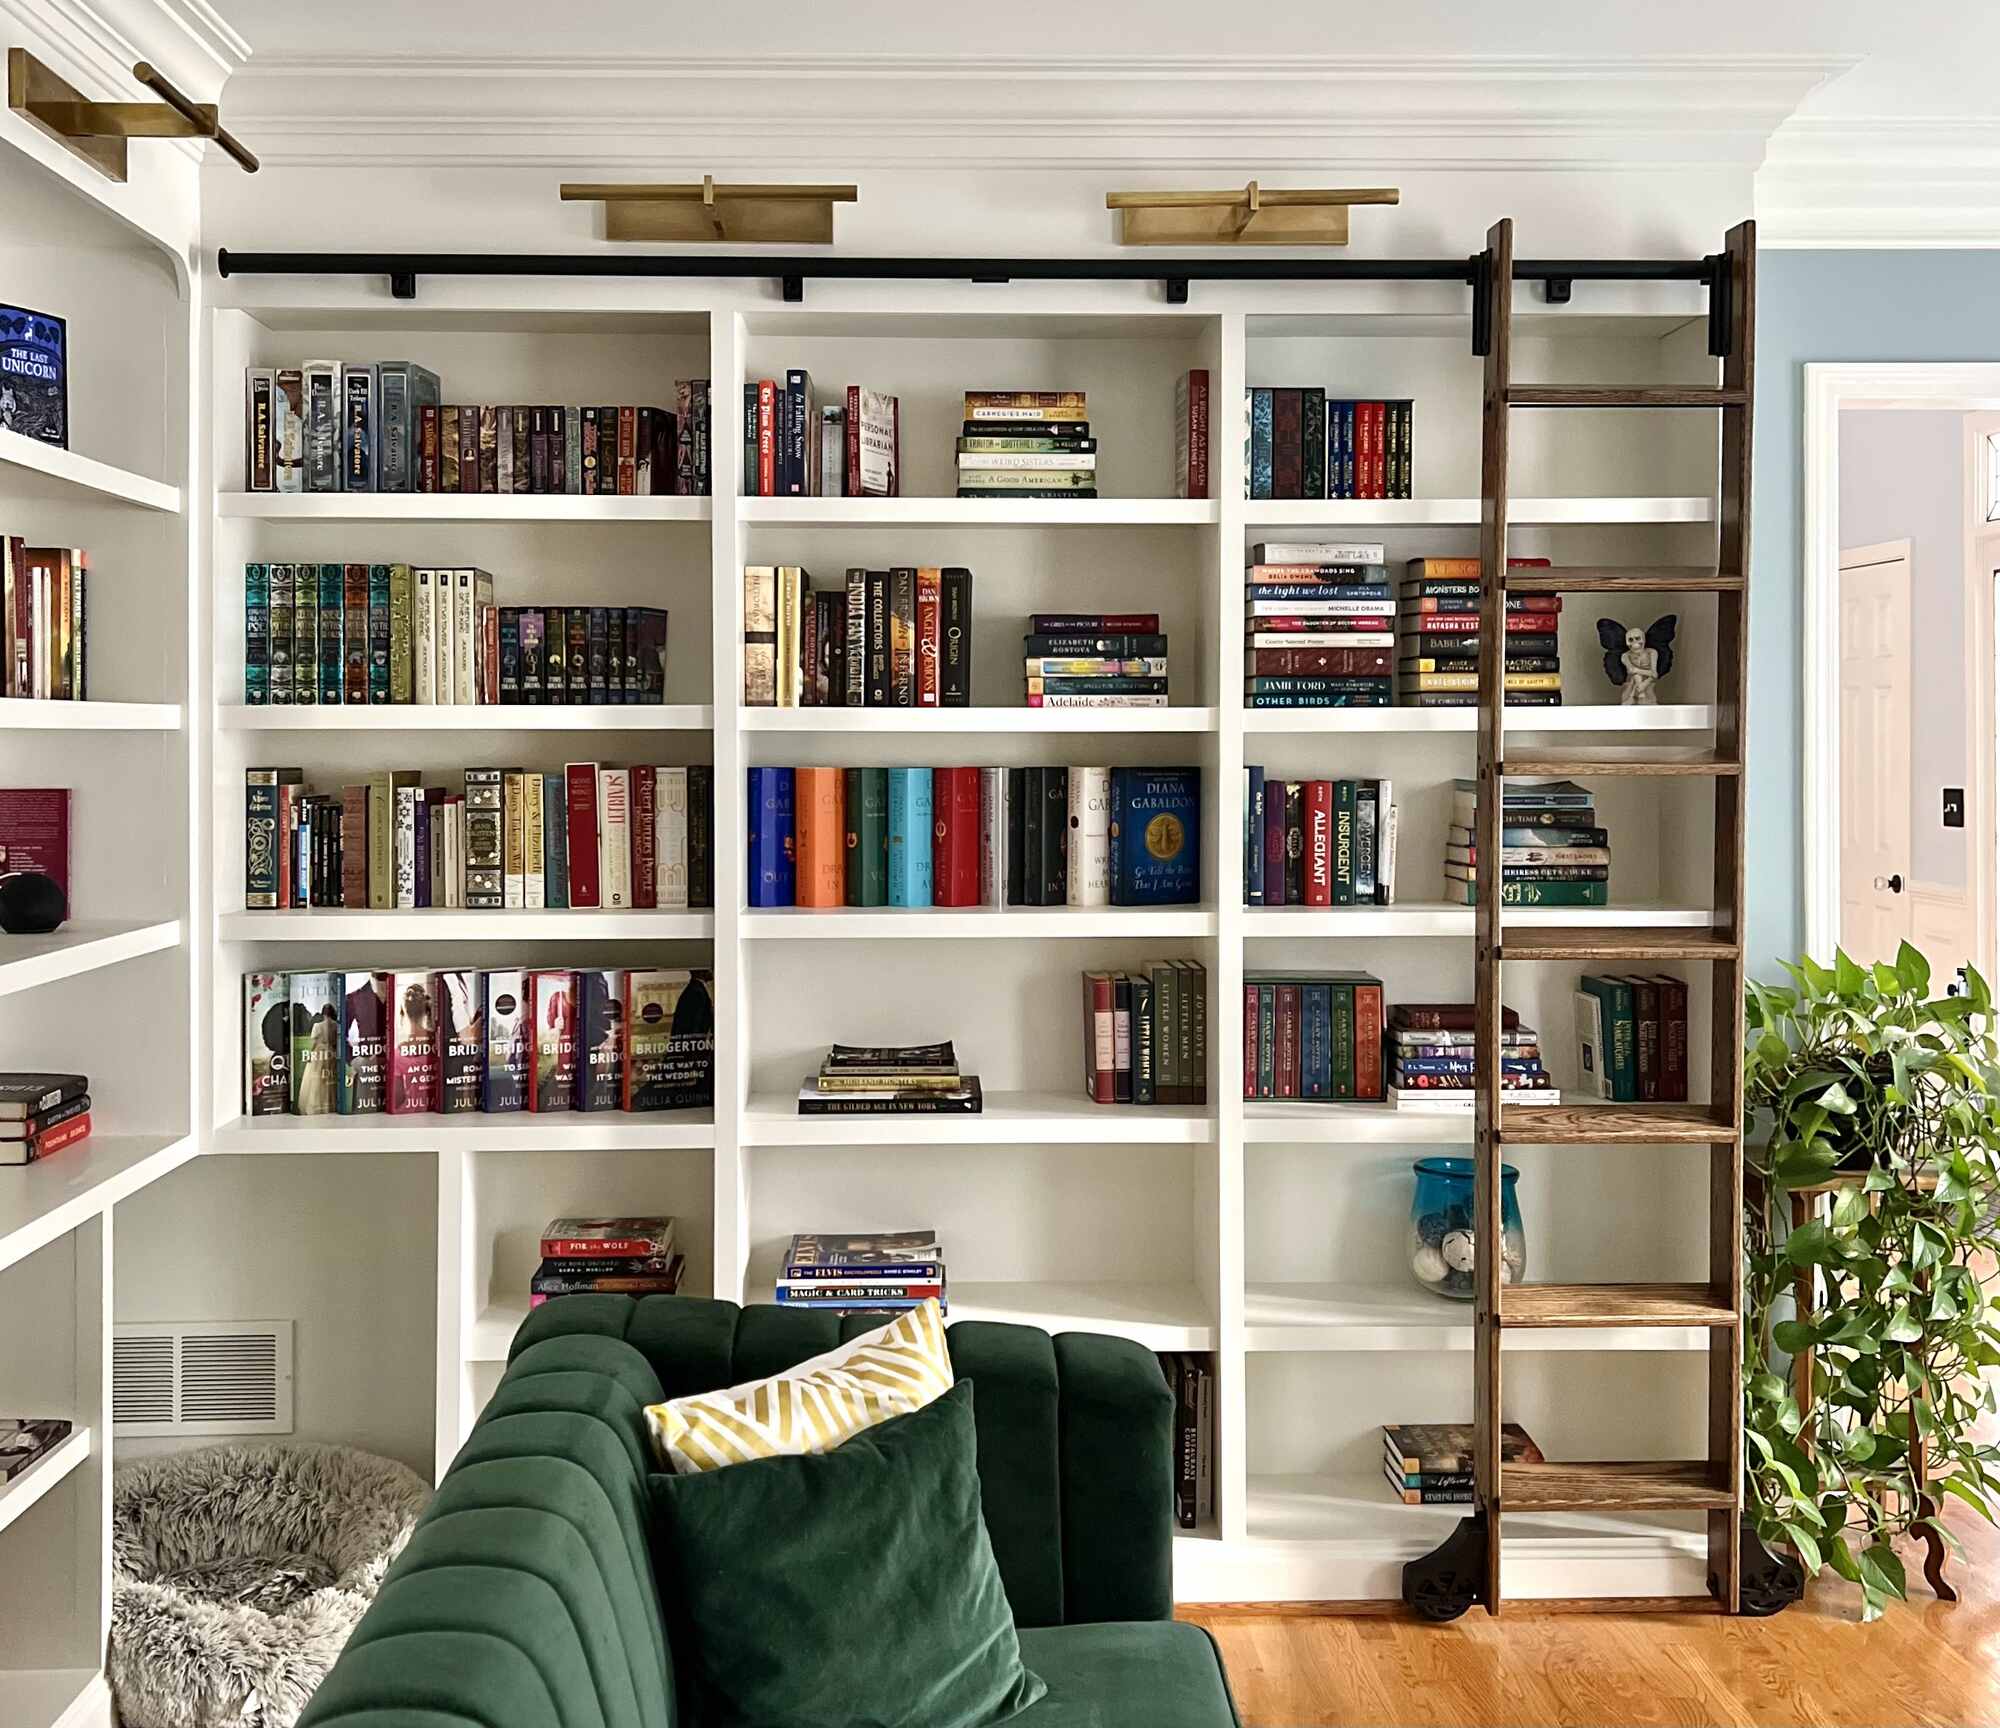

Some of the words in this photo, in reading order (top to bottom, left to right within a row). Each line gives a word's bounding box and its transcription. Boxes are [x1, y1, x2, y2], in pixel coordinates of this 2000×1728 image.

[11, 347, 28, 360] THE
[30, 351, 49, 364] LAST
[2, 356, 57, 380] UNICORN
[761, 387, 771, 404] The
[795, 393, 804, 402] In
[1198, 386, 1207, 398] AS
[257, 403, 267, 423] R.A.
[353, 404, 362, 423] R.A.
[761, 405, 771, 426] Plum
[793, 405, 803, 433] Falling
[1198, 401, 1207, 432] BRIGHT
[860, 420, 893, 438] PERSONAL
[257, 424, 267, 469] Salvatore
[316, 425, 327, 471] Salvatore
[353, 426, 362, 475] Salvatore
[390, 427, 398, 473] Salvatore
[761, 429, 771, 454] Trees
[795, 436, 804, 459] Snow
[861, 437, 894, 452] LIBRARIAN
[1198, 435, 1207, 448] AS
[1020, 456, 1054, 465] SISTERS
[1198, 450, 1207, 486] HEAVEN
[873, 580, 882, 597] THE
[897, 570, 908, 595] DAN
[922, 588, 936, 596] DAN
[1258, 586, 1272, 595] the
[1274, 586, 1300, 598] light
[1318, 586, 1339, 595] lost
[1425, 585, 1467, 594] MONSTERS
[849, 582, 865, 617] INDIA
[918, 595, 940, 603] BROWN
[848, 618, 865, 641] FAN
[873, 598, 882, 650] COLLECTORS
[923, 605, 934, 641] ANGELS
[921, 638, 937, 657] &
[947, 627, 962, 665] ORIGIN
[1429, 639, 1463, 648] BABEL
[895, 650, 910, 705] INFERNO
[923, 656, 934, 691] DEMONS
[1263, 681, 1292, 690] JAMIE
[1296, 681, 1326, 690] FORD
[1046, 695, 1095, 707] Adelaide
[1256, 697, 1293, 705] OTHER
[1298, 697, 1330, 705] BIRDS
[530, 778, 541, 807] Darcy
[641, 780, 655, 811] RHETT
[1146, 783, 1185, 794] DIANA
[511, 787, 521, 813] Darcy
[605, 775, 625, 825] SCARLETT
[1131, 797, 1195, 809] GABALDON
[511, 818, 521, 844] Takes
[641, 813, 655, 854] BUTLER'S
[531, 824, 541, 873] Elizabeth
[1313, 809, 1326, 886] ALLEGIANT
[1337, 810, 1350, 885] INSURGENT
[1360, 820, 1371, 885] DIVERGENT
[511, 852, 521, 872] Wife
[641, 857, 655, 891] PEOPLE
[1135, 879, 1151, 890] That
[1181, 993, 1189, 1029] LITTLE
[1141, 1015, 1150, 1046] LITTLE
[635, 1039, 715, 1055] BRIDGERTON
[1181, 1036, 1189, 1059] MEN
[361, 1065, 380, 1074] THE
[407, 1066, 420, 1074] AN
[503, 1064, 516, 1072] TO
[642, 1063, 656, 1072] ON
[657, 1062, 676, 1071] THE
[676, 1061, 695, 1069] WAY
[695, 1060, 709, 1068] TO
[1141, 1047, 1150, 1079] WOMEN
[1449, 1060, 1468, 1072] Mrs.
[360, 1075, 382, 1084] WHO
[446, 1076, 477, 1085] MISTER
[555, 1074, 573, 1082] WAS
[596, 1073, 614, 1082] IT'S
[646, 1073, 664, 1082] THE
[664, 1070, 705, 1080] WEDDING
[640, 1094, 673, 1107] JULIA
[674, 1092, 710, 1104] QUINN
[826, 1103, 841, 1111] THE
[842, 1103, 872, 1111] GILDED
[898, 1103, 915, 1111] NEW
[917, 1103, 937, 1111] YORK
[815, 1268, 843, 1277] ELVIS
[537, 1282, 559, 1291] Alice
[560, 1281, 600, 1291] Hoffman
[789, 1289, 824, 1298] MAGIC
[836, 1288, 865, 1297] CARD
[866, 1288, 904, 1297] TRICKS
[1437, 1476, 1468, 1487] Leftover
